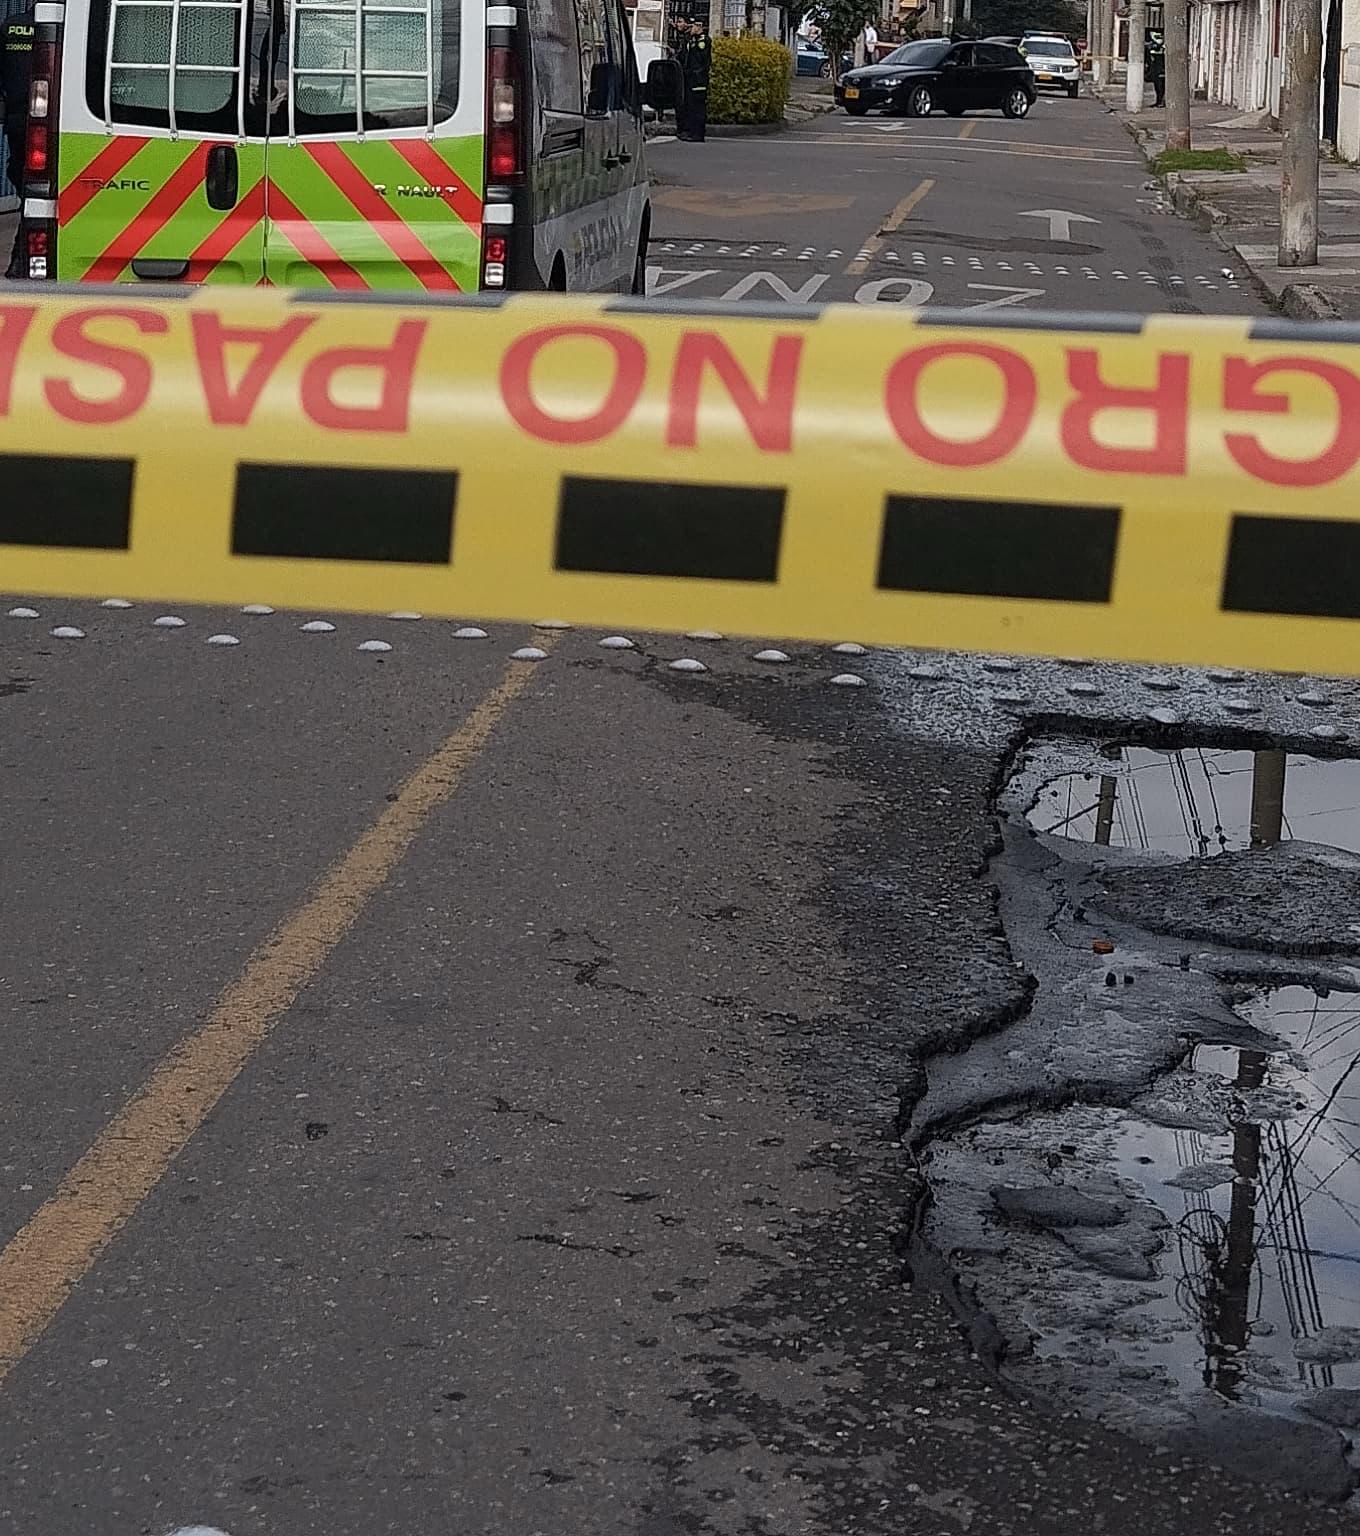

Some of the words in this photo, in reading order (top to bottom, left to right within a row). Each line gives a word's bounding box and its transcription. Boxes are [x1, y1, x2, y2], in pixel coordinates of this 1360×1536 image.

[79, 178, 150, 191] TRAFIC
[373, 184, 459, 198] RNAULT
[497, 324, 806, 452] NO
